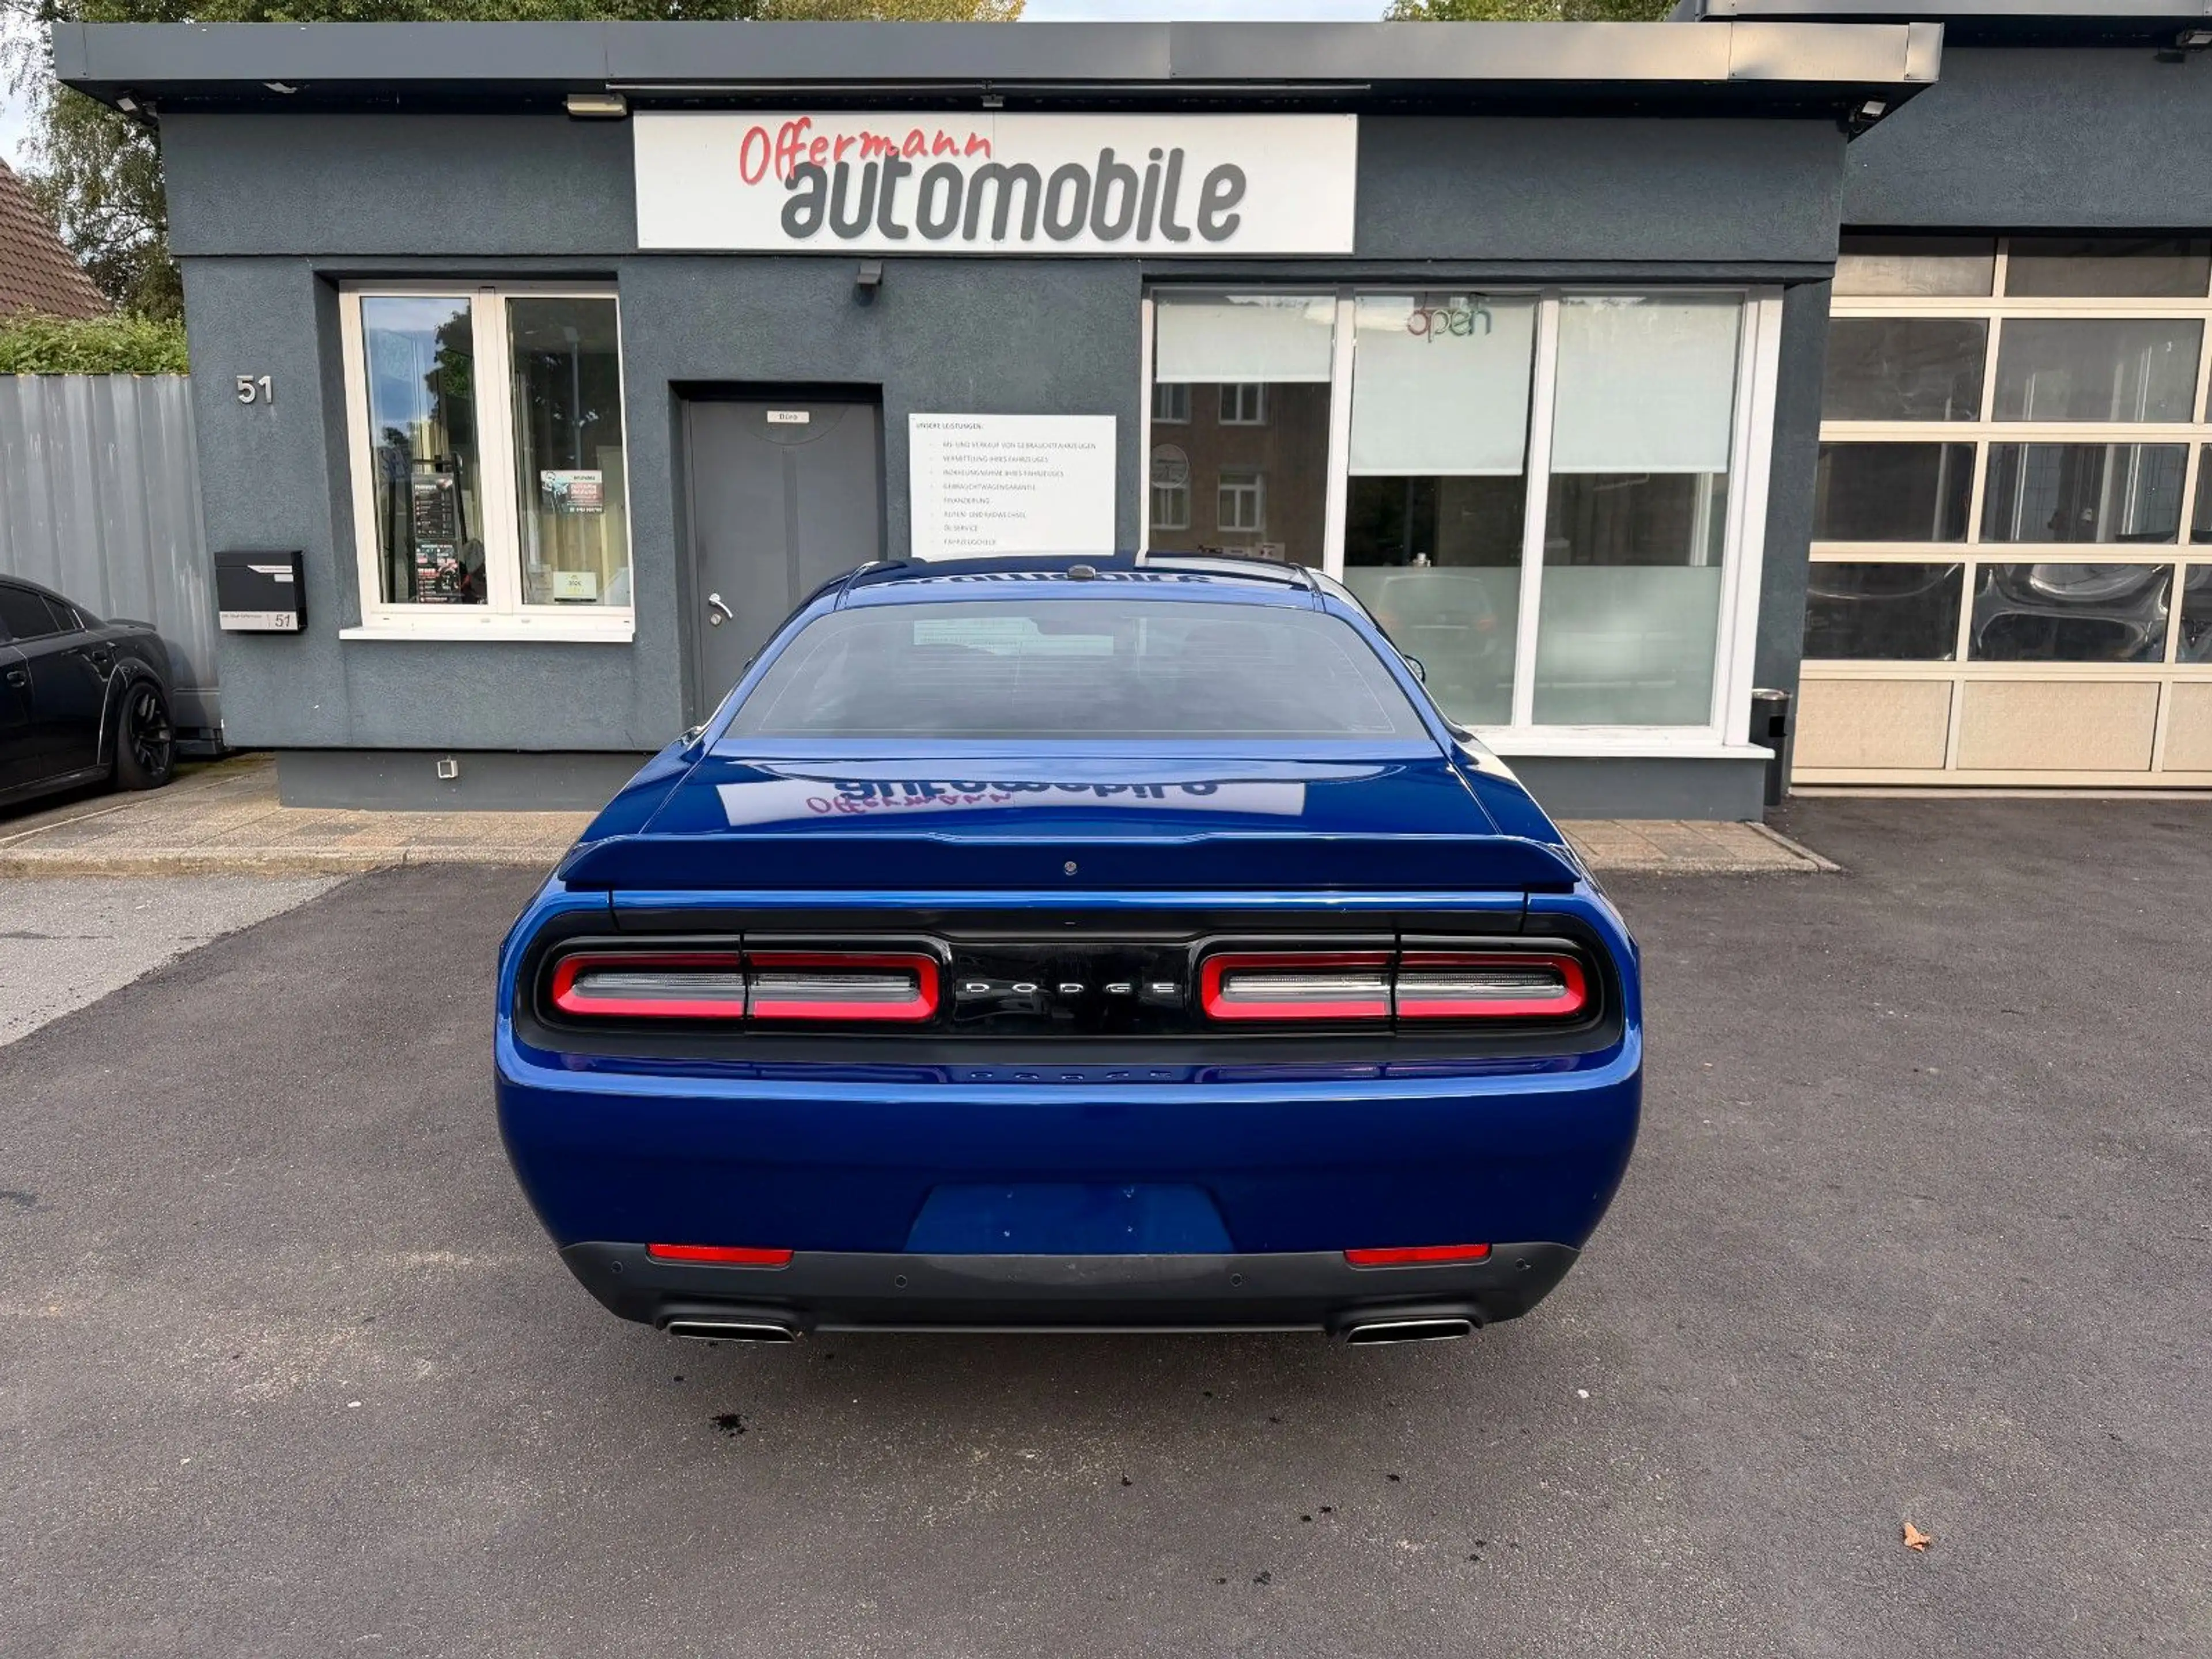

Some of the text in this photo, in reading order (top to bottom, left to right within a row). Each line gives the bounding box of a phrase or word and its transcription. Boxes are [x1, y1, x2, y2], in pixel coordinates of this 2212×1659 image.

[739, 117, 992, 185] Offermann
[780, 146, 1247, 243] automobile
[1407, 308, 1491, 343] open
[236, 375, 273, 404] 51
[275, 613, 290, 627] 51
[966, 983, 1175, 993] DODGE
